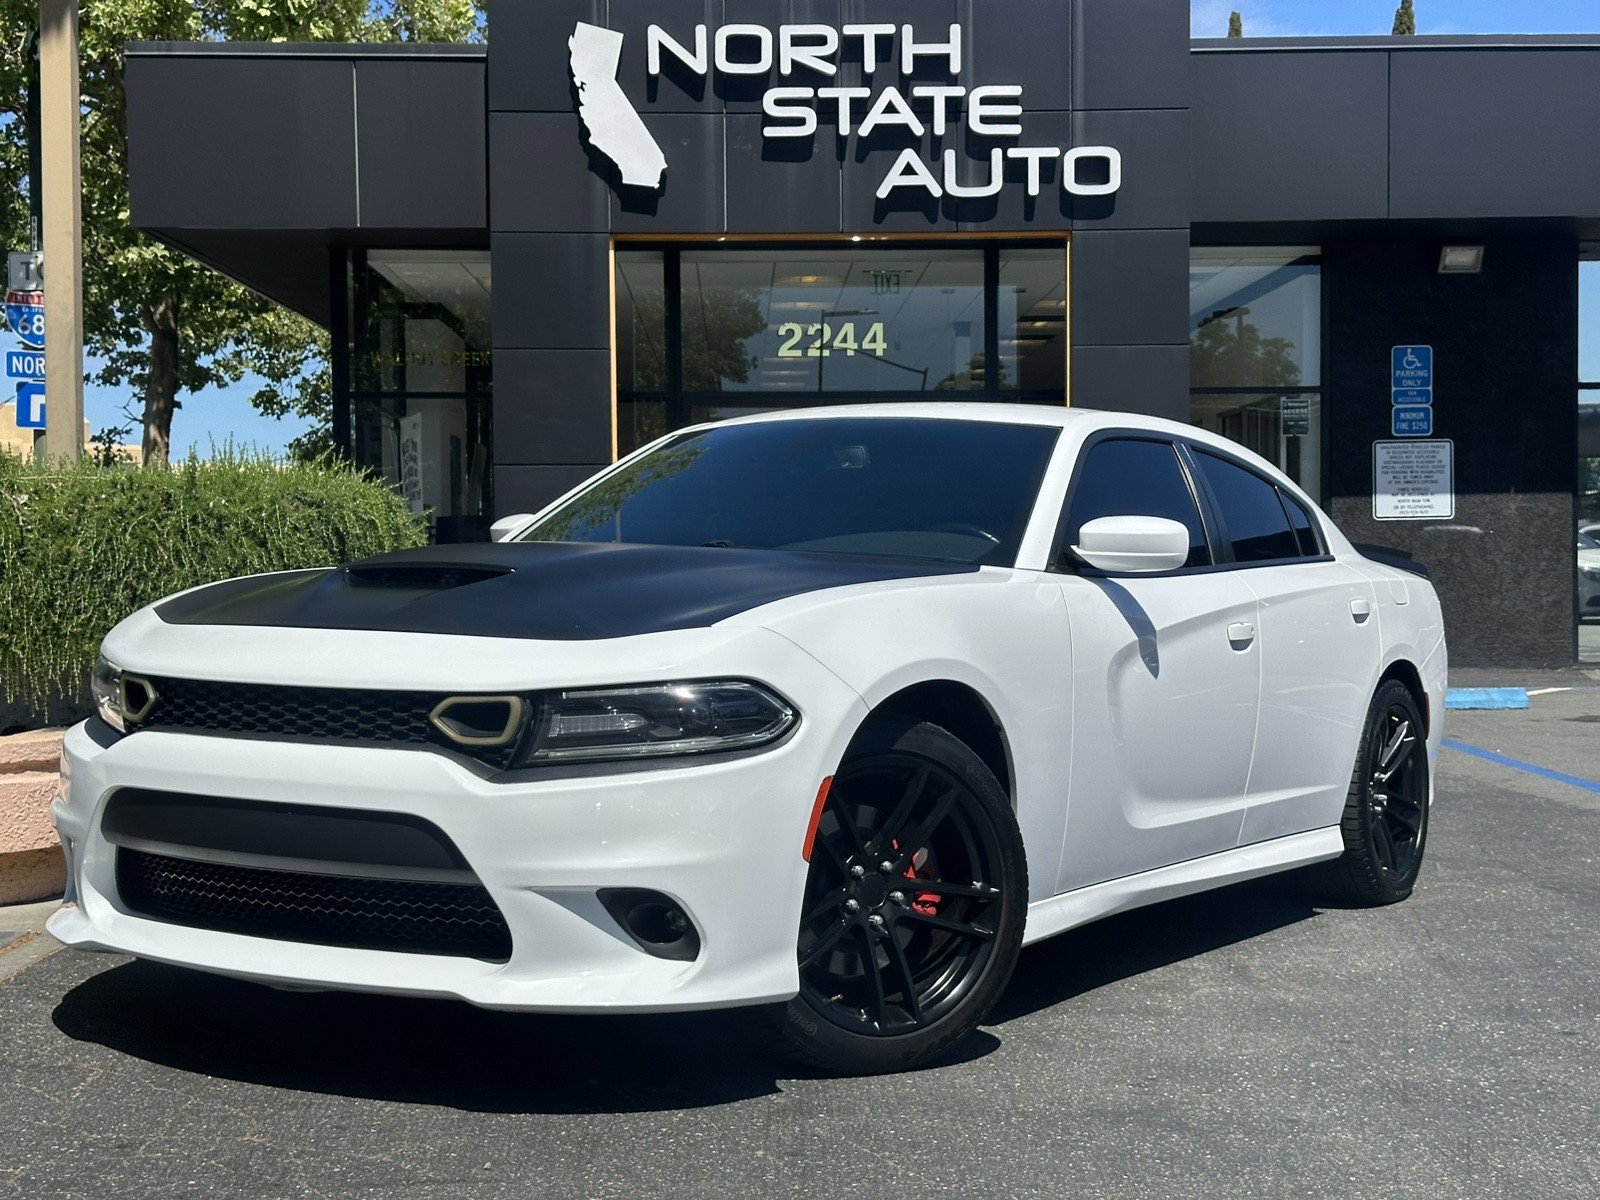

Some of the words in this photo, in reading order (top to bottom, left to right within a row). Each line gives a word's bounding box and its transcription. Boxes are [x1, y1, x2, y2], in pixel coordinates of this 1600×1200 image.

[646, 23, 962, 76] NORTH
[762, 84, 1023, 138] STATE
[875, 145, 1122, 200] AUTO
[17, 314, 45, 336] 68
[777, 322, 887, 357] 2244
[12, 355, 46, 374] NOR
[1395, 369, 1429, 377] PARKING
[1396, 421, 1410, 430] FINE
[1411, 421, 1428, 431] $250
[1400, 411, 1425, 420] MINIMUM
